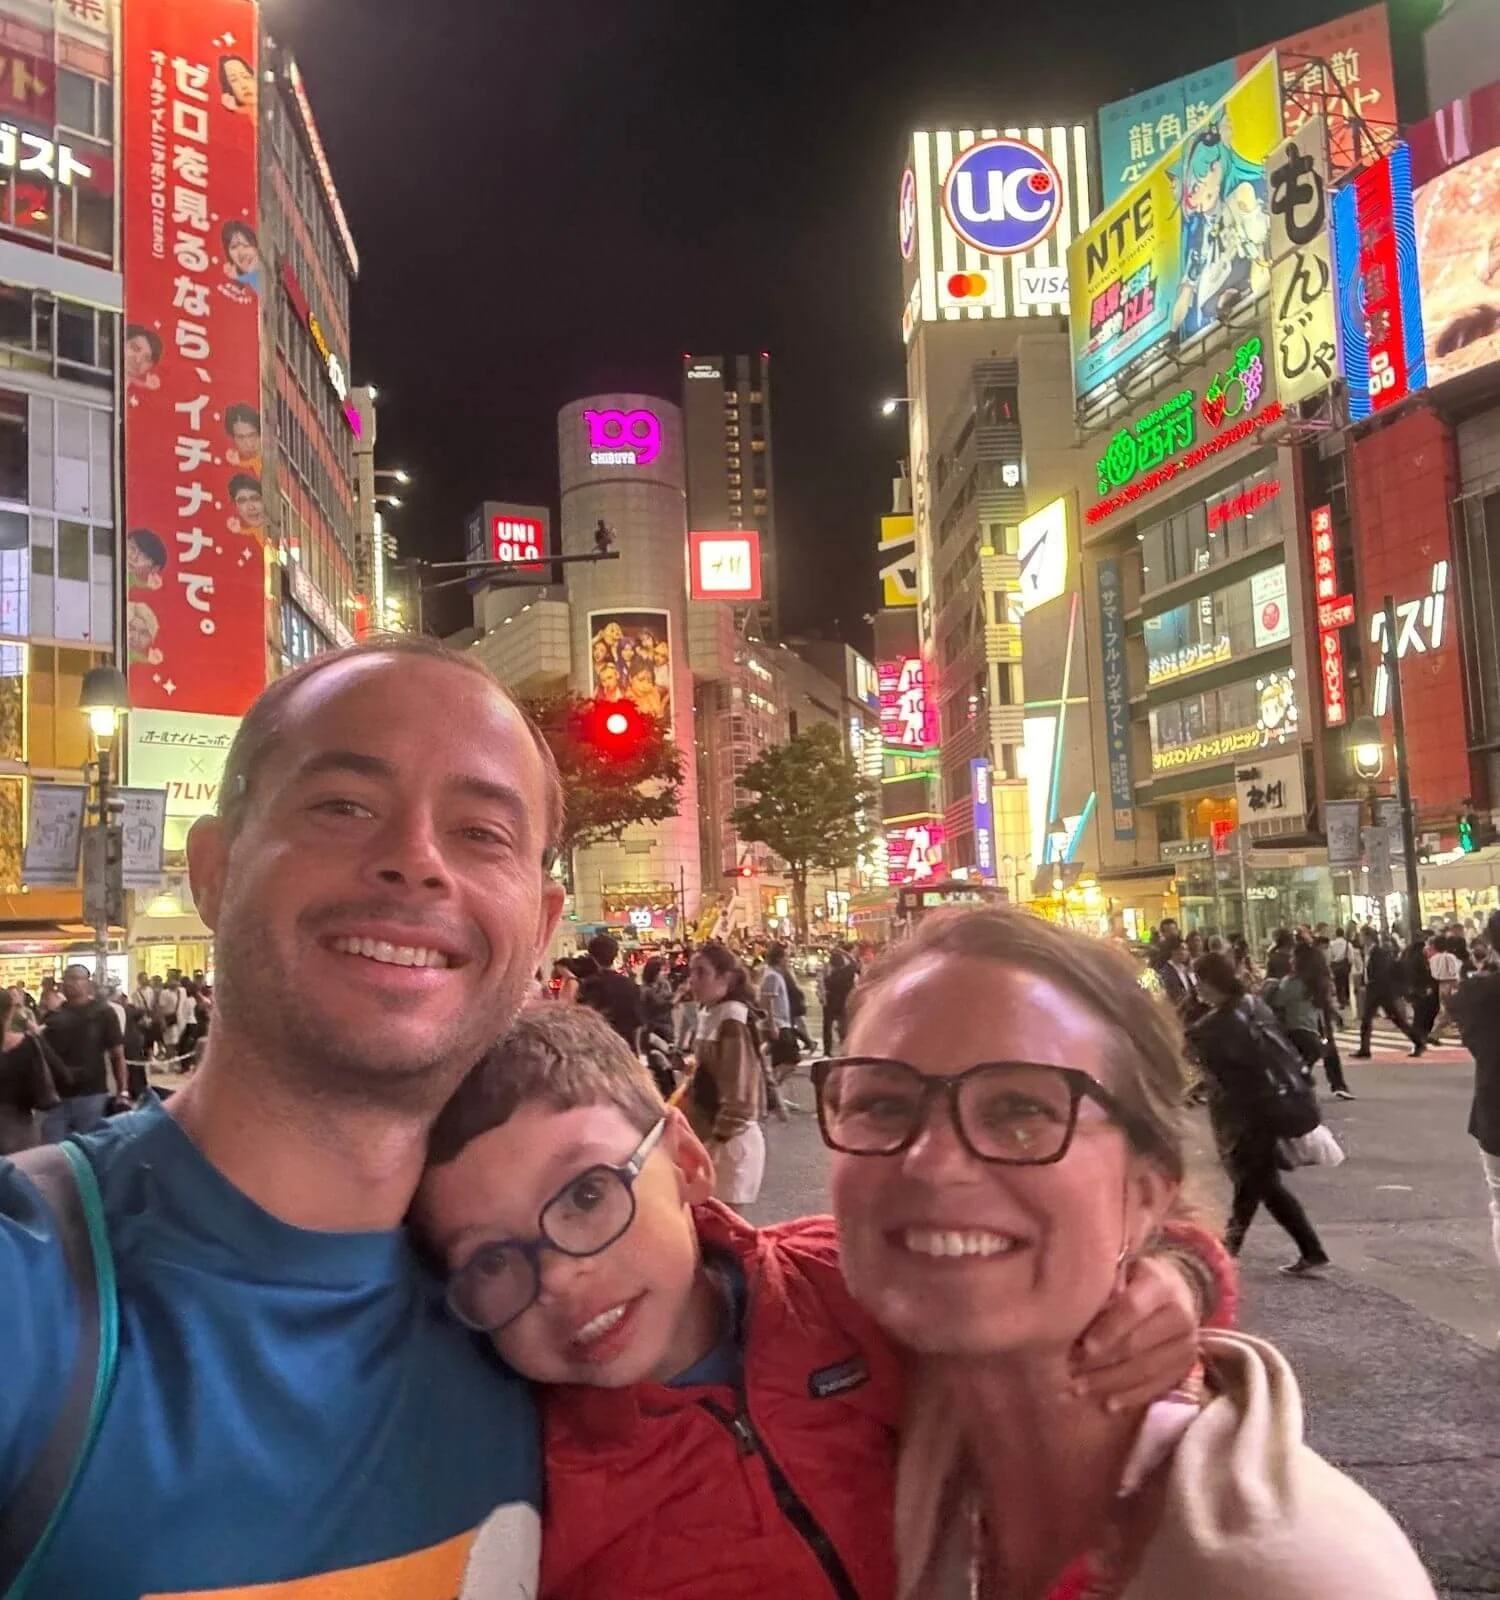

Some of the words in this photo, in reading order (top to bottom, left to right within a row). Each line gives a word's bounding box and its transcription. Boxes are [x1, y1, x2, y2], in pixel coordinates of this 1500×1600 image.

[1086, 188, 1154, 284] NTE
[1271, 142, 1338, 380] もんじゃ
[583, 409, 662, 464] 109
[497, 521, 535, 544] UNI
